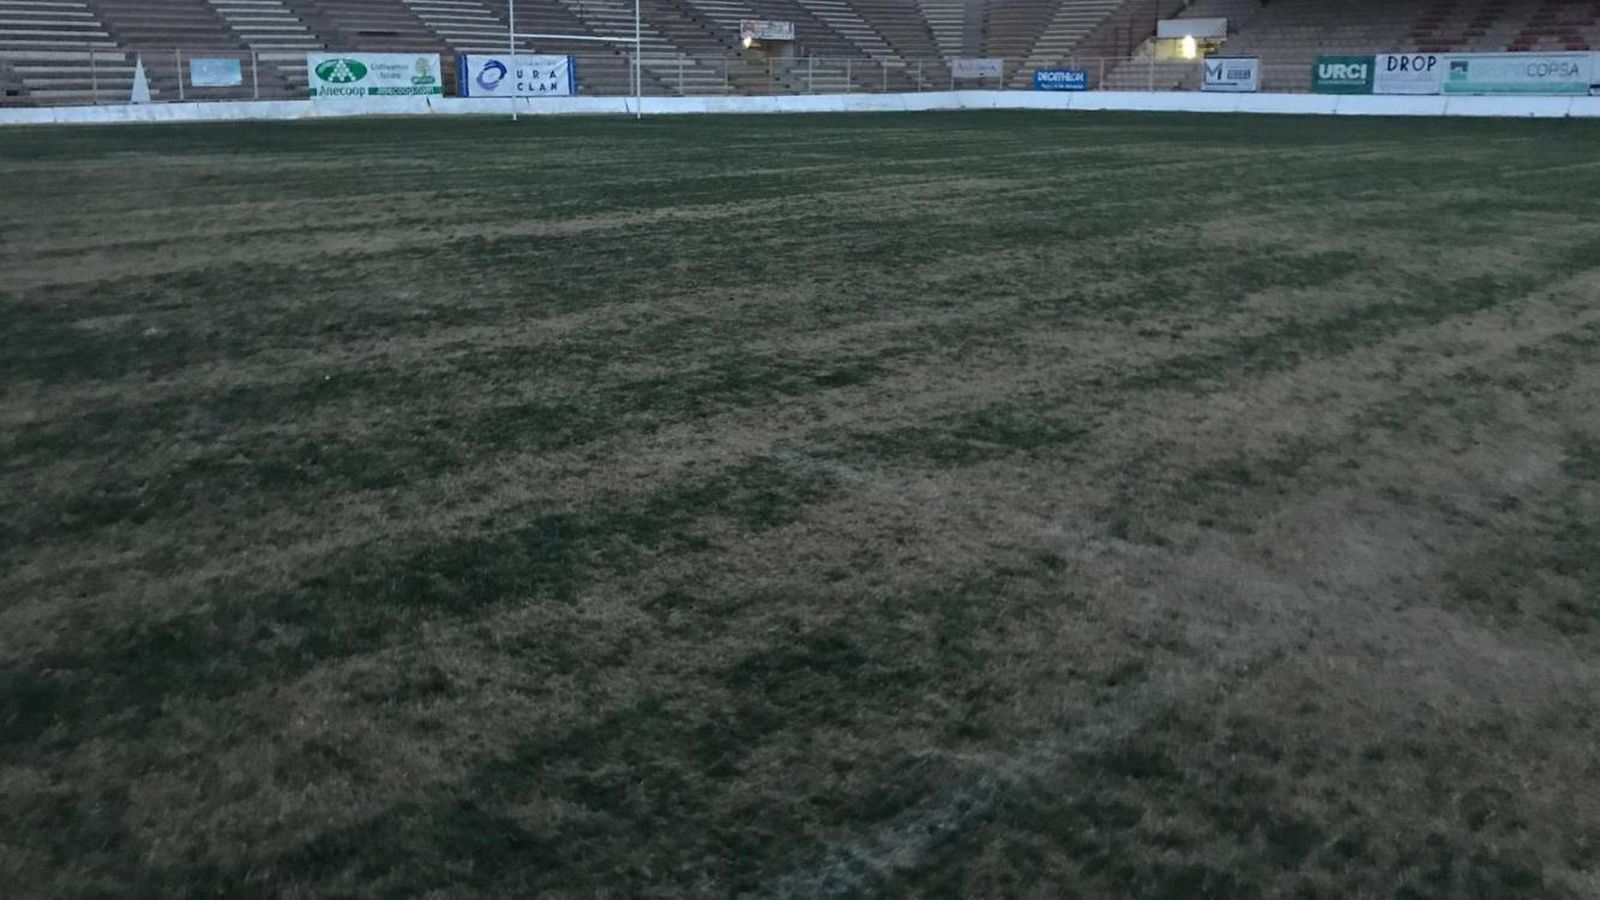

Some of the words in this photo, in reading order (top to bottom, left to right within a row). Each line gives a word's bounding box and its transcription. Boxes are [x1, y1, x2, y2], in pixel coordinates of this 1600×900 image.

[1387, 55, 1436, 71] DROP
[1318, 63, 1368, 79] URCI
[1526, 63, 1579, 77] COPSA
[1037, 71, 1084, 82] DECATHLON
[318, 86, 366, 97] Anecoop
[516, 82, 557, 92] CLAN
